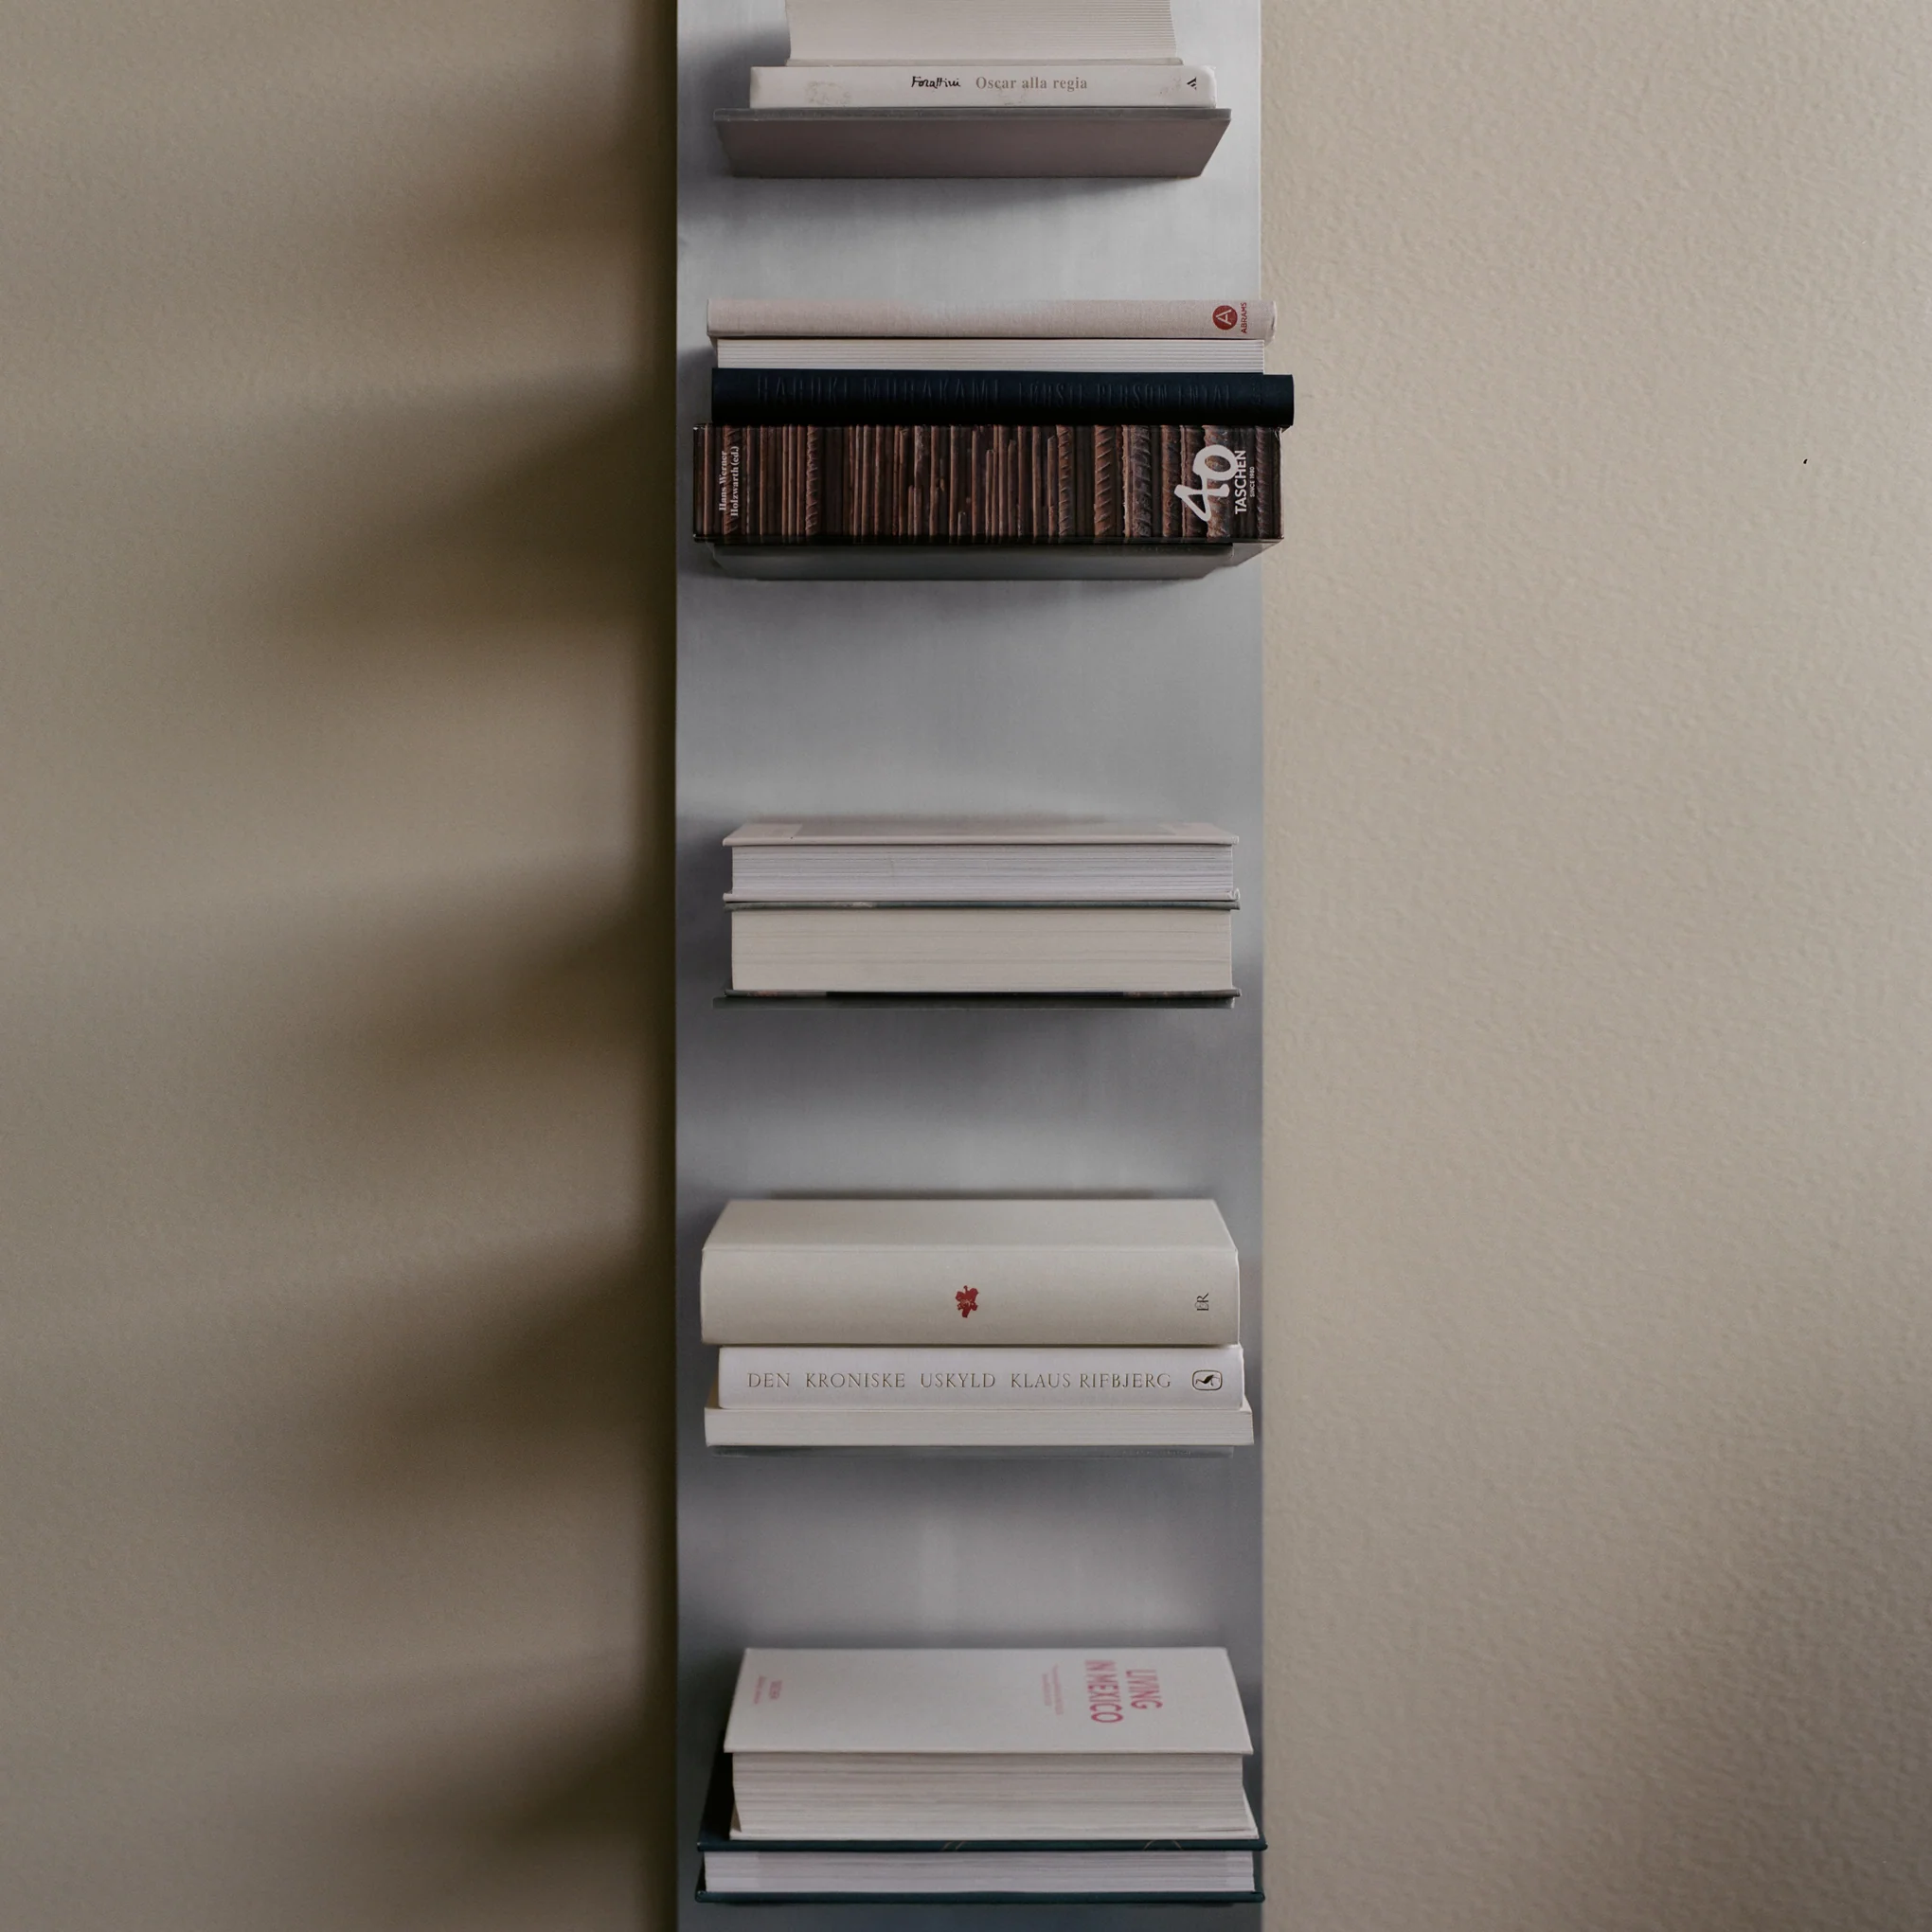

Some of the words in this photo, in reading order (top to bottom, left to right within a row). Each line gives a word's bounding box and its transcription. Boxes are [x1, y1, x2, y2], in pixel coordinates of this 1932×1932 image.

[975, 77, 1017, 89] Oscar
[1022, 77, 1047, 89] alla
[1053, 77, 1088, 92] regia
[719, 450, 727, 485] Werner
[730, 445, 740, 466] (ed.)
[730, 467, 739, 517] Holzwarth
[1234, 450, 1247, 514] TASCHEN
[719, 486, 727, 511] Hans
[747, 1373, 791, 1388] DEN
[806, 1373, 905, 1388] KRONISKE
[920, 1373, 995, 1388] USKYLD
[1011, 1373, 1071, 1388] KLAUS
[1080, 1373, 1172, 1388] RIFBJERG
[1084, 1659, 1118, 1672] IN
[1086, 1673, 1124, 1724] MEXICO
[1125, 1669, 1164, 1710] LIVING
